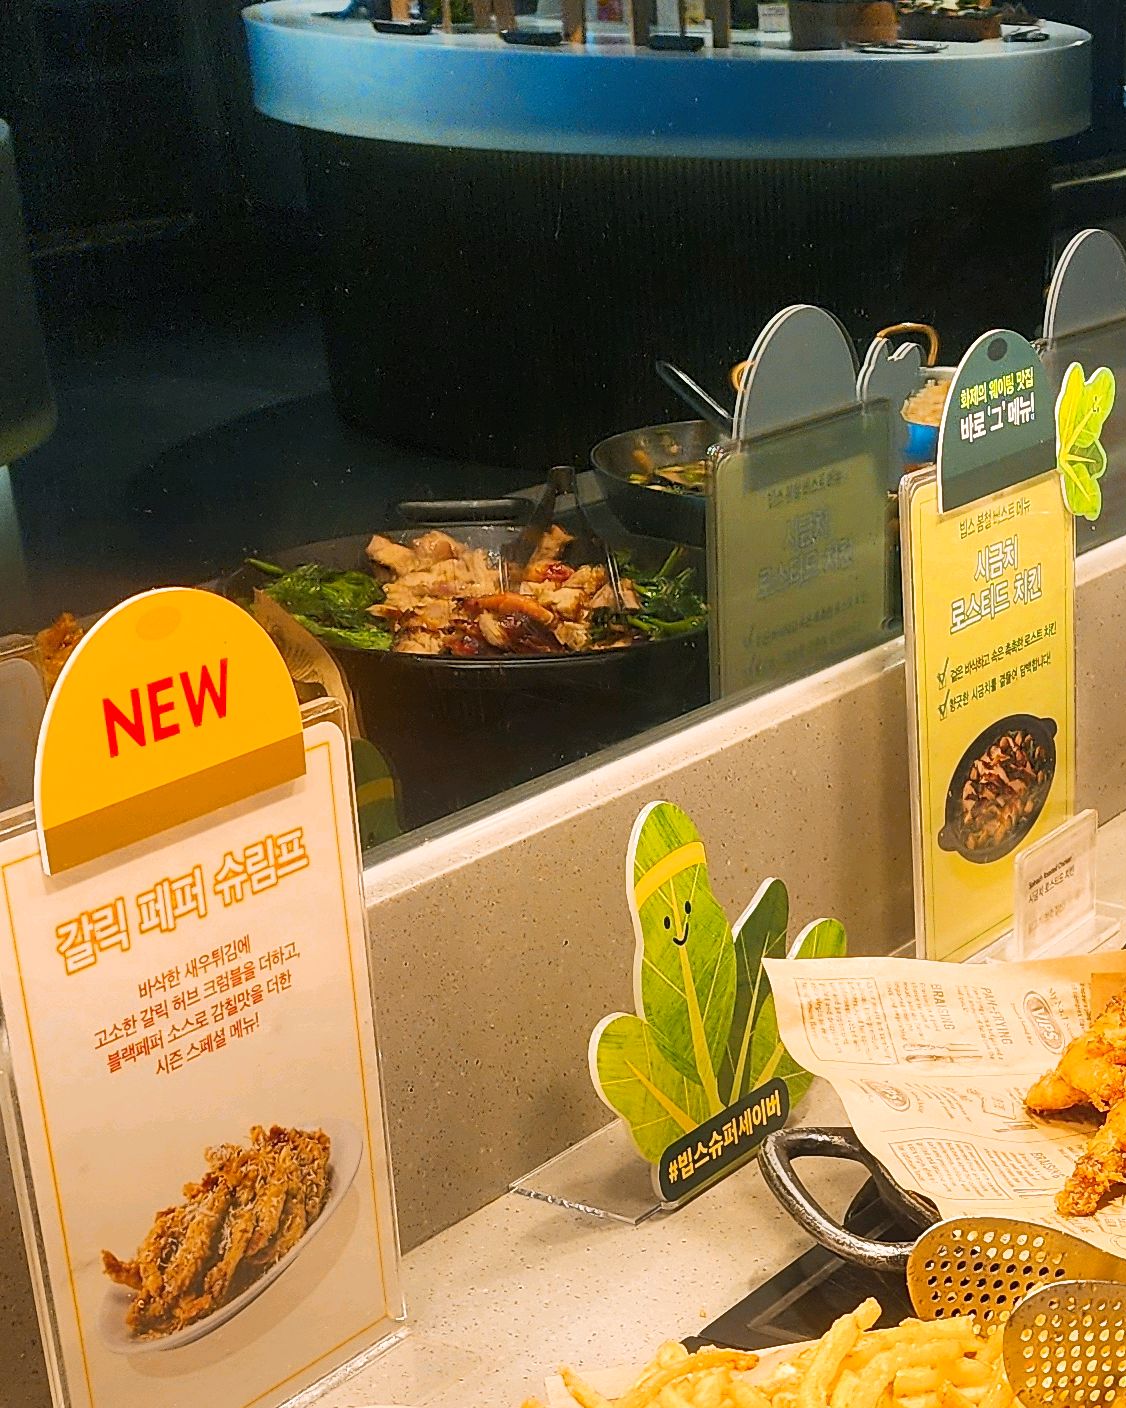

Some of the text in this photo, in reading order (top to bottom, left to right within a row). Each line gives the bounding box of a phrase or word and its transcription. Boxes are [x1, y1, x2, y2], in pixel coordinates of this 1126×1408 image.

[960, 366, 1034, 410] 화제의 웨이팅 맛집
[960, 409, 986, 443] 바로
[1007, 392, 1035, 426] 메뉴!
[960, 518, 975, 539] 빕스
[1016, 497, 1031, 515] 메뉴
[974, 534, 1019, 582] 시금치
[950, 562, 1042, 635] 로스티드 치킨
[964, 653, 990, 675] 바삭하고
[1005, 637, 1023, 655] 촉촉한
[1024, 629, 1042, 647] 로스트
[1044, 621, 1057, 638] 치킨
[103, 658, 228, 758] NEW
[950, 691, 969, 712] 향긋한
[972, 678, 996, 701] 시금치를
[55, 827, 309, 976] 갈릭 페퍼 슈림프
[94, 941, 300, 1050] 고소한 갈릭 허브 크럼블을 더하고,
[138, 935, 251, 999] 바삭한 새우튀김에
[107, 970, 292, 1074] 블랙페퍼 소스로 감칠맛을 더한
[930, 983, 956, 1030] BRAISING
[981, 986, 1013, 1045] PAN-FRYING
[1031, 1006, 1058, 1040] VIPS
[155, 1012, 260, 1076] 시즌 스페셜 메뉴!
[668, 1089, 782, 1184] #빕스슈퍼세이버
